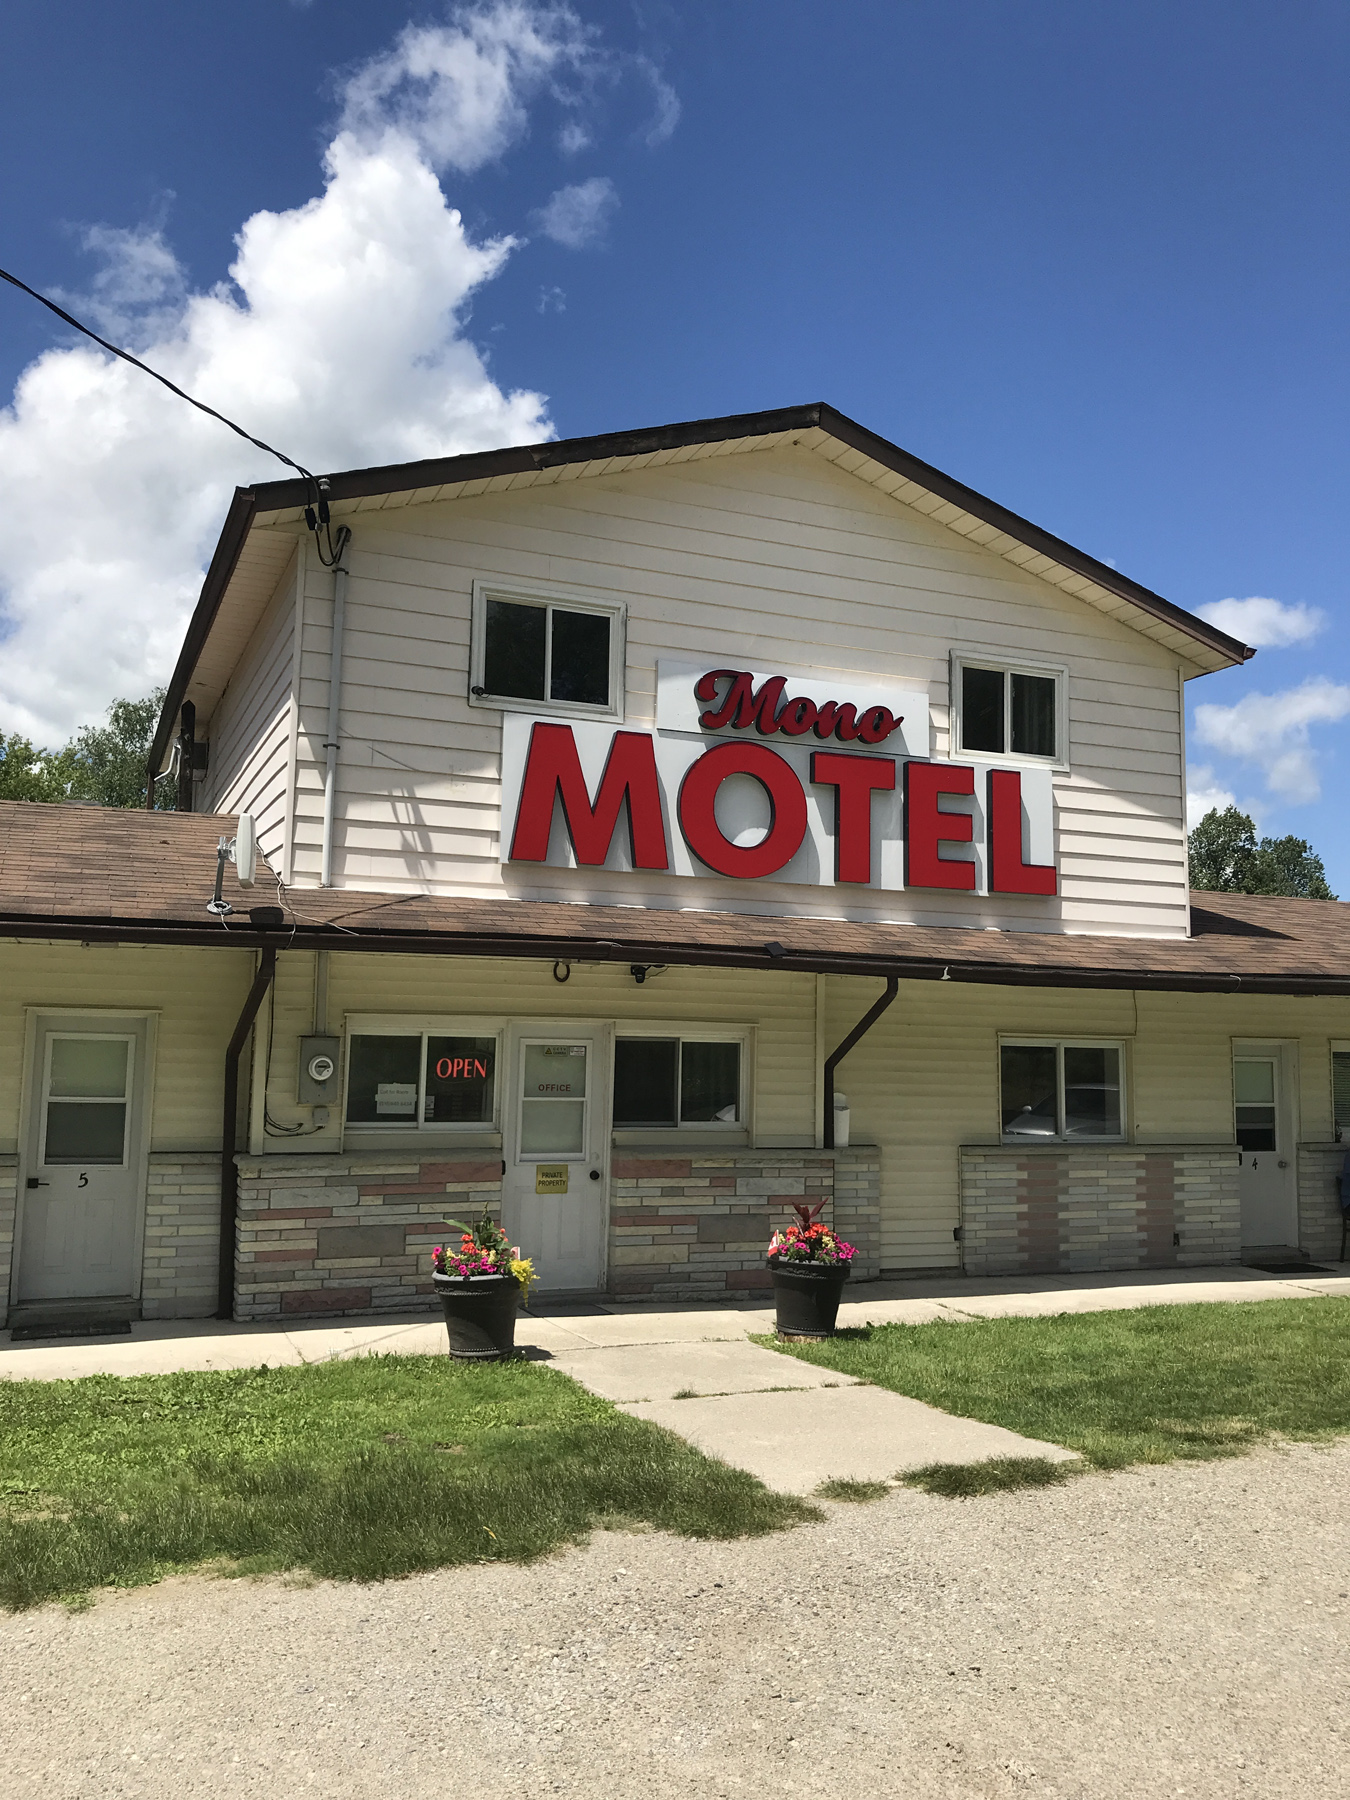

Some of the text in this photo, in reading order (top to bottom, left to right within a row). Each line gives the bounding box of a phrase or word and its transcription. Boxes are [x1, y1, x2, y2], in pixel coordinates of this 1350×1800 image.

[694, 669, 904, 744] Mono
[508, 721, 1057, 895] MOTEL
[436, 1057, 487, 1078] OPEN
[538, 1083, 571, 1092] OFFICE
[1251, 1157, 1258, 1170] 4
[77, 1172, 89, 1188] 5
[541, 1171, 563, 1179] PRIVATE
